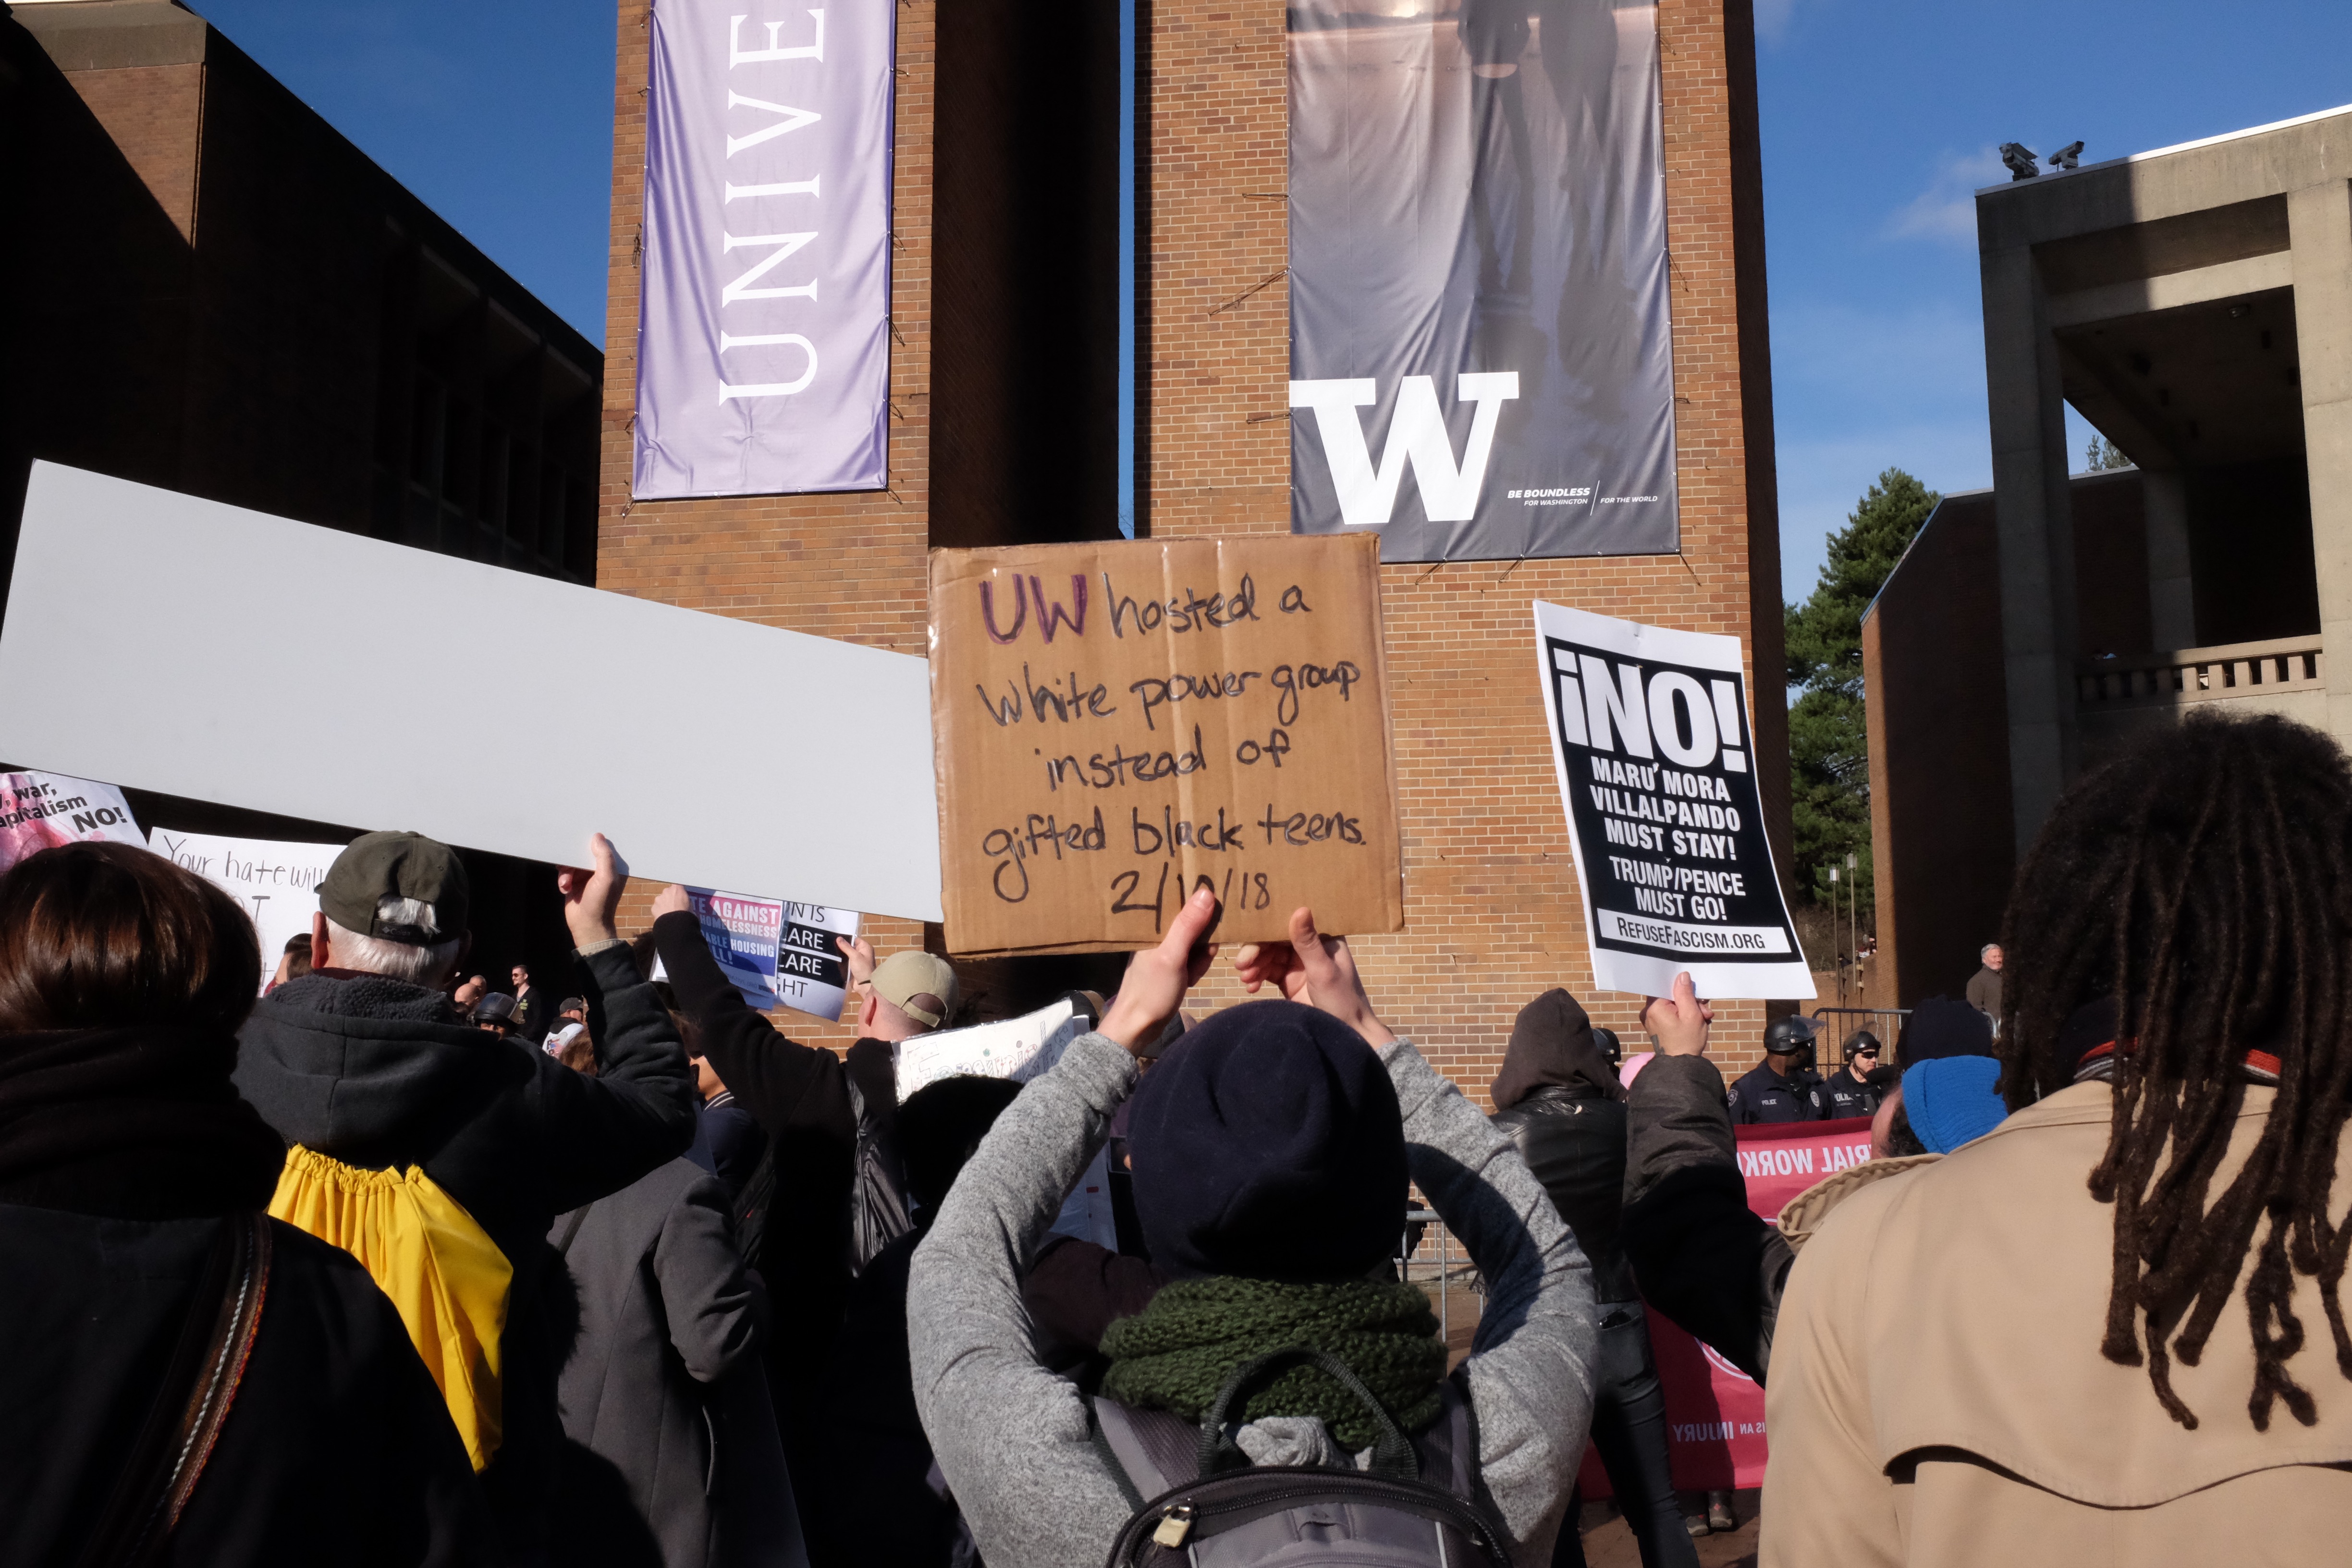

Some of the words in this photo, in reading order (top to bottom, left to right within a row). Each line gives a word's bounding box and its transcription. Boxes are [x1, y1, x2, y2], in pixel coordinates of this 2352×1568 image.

[719, 9, 824, 406] UNIVE
[1289, 371, 1519, 525] W
[1507, 490, 1522, 498] BE
[1524, 488, 1590, 498] BOUNDLESS
[979, 574, 1088, 644] UW
[1102, 572, 1261, 638] hosted
[1279, 585, 1312, 613] a
[1130, 670, 1262, 730] power
[1271, 661, 1361, 726] group
[1035, 723, 1206, 792] instead
[1236, 728, 1290, 768] of
[12, 783, 57, 801] war,
[1662, 770, 1731, 802] MORA
[72, 807, 128, 833] NO!
[1590, 785, 1741, 832] VILLALPANDO
[982, 806, 1106, 903] gifted
[1132, 805, 1244, 858] black
[1605, 817, 1664, 852] MUST
[1672, 830, 1737, 860] STAY!
[164, 835, 217, 874] Your
[226, 851, 286, 886] hate
[1609, 856, 1746, 896] TRUMP/PENCE
[712, 900, 778, 924] AGAINST
[810, 906, 825, 922] IS
[1635, 887, 1684, 917] MUST
[1691, 895, 1727, 921] GO!
[700, 914, 777, 938] HOMELESSNESS
[731, 939, 775, 957] HOUSING
